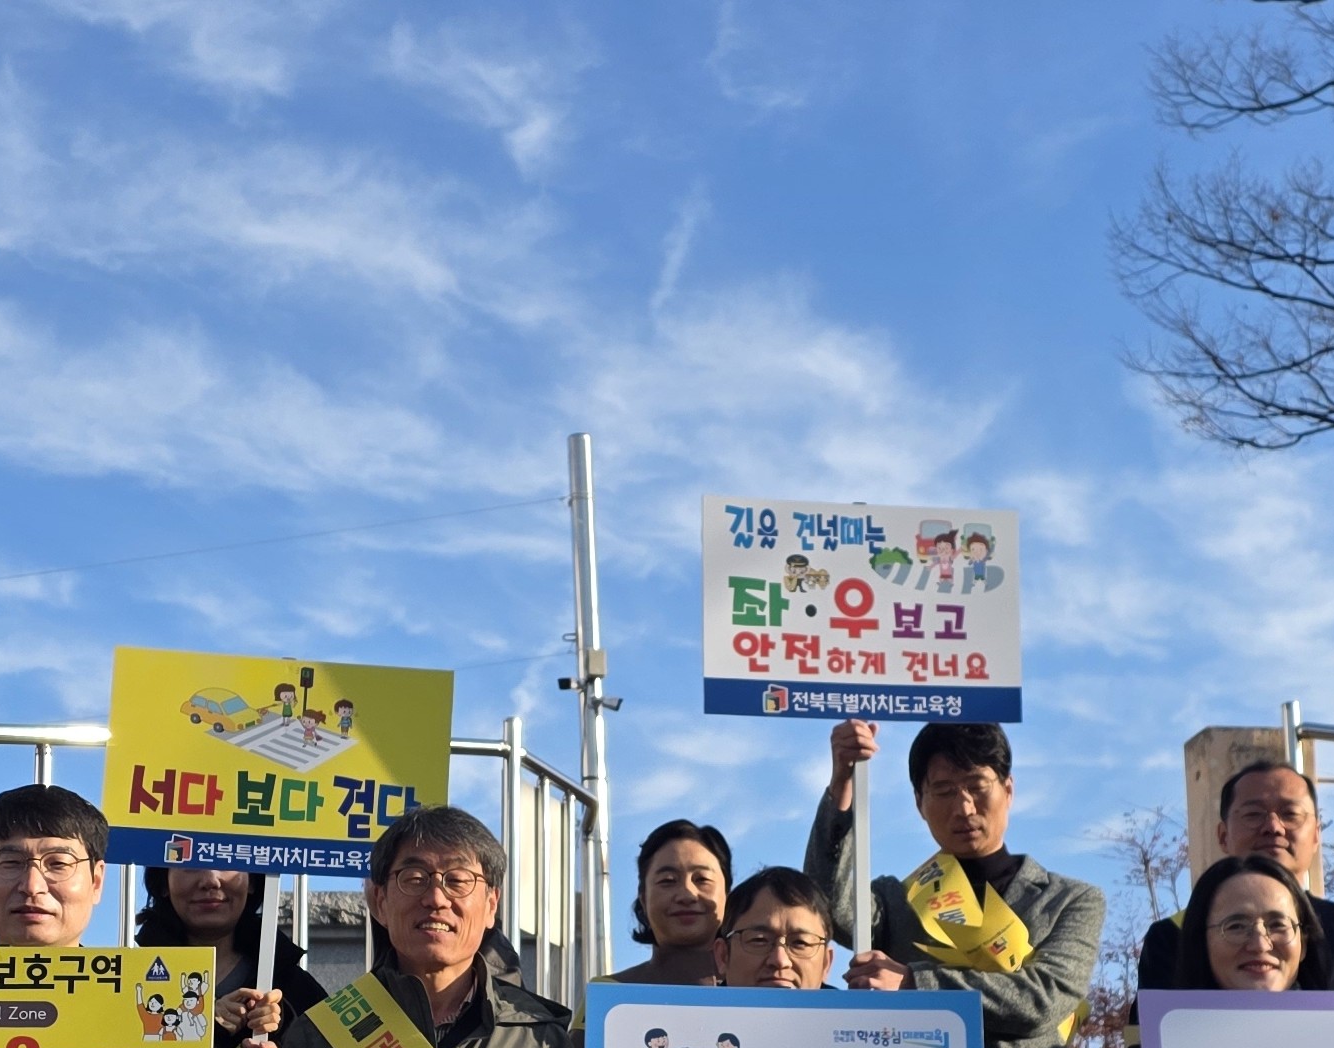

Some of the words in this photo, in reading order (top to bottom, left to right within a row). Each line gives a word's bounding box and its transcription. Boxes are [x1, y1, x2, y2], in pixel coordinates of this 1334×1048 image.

[725, 505, 778, 550] 길을
[892, 602, 967, 640] 보고
[732, 631, 886, 675] 안전하게
[902, 650, 990, 682] 건너요
[792, 691, 962, 715] 전북특별자치도교육청
[129, 764, 225, 817] 서다
[232, 770, 325, 827] 보다
[8, 1005, 47, 1021] Zone
